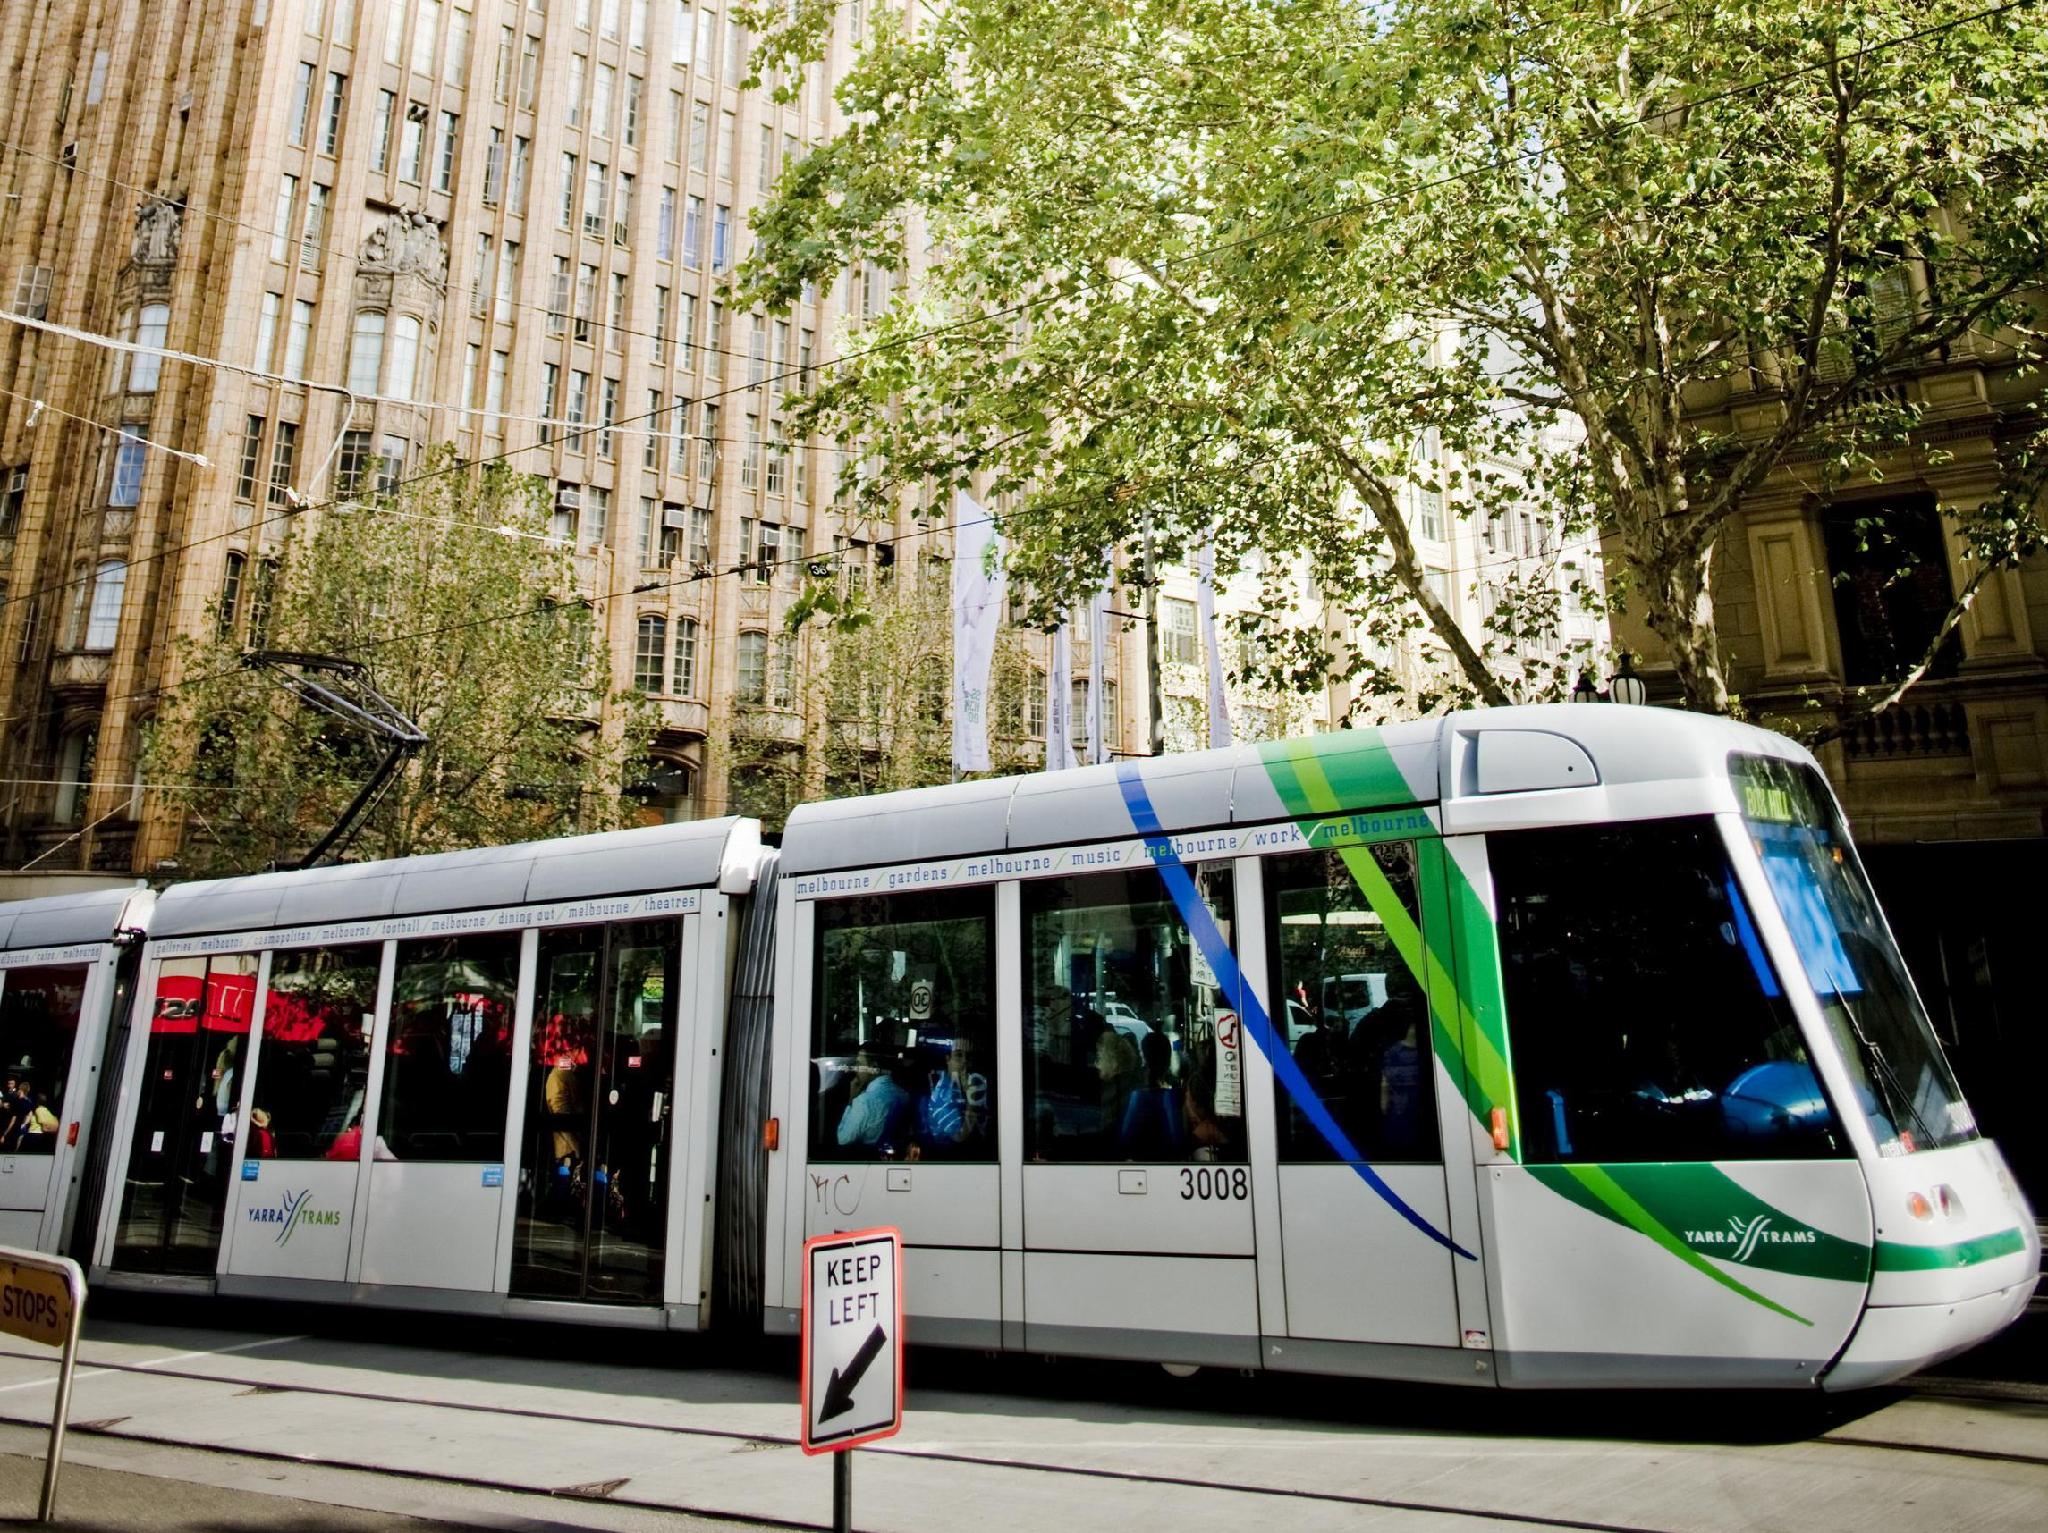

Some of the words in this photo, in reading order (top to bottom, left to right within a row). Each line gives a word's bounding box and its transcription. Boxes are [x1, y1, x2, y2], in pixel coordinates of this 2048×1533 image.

[797, 876, 870, 894] melbourne
[889, 867, 947, 889] gardens
[967, 856, 1051, 877] melbourne
[1072, 848, 1121, 865] music
[1144, 834, 1238, 859] melbourne
[1255, 825, 1300, 846] work
[1323, 814, 1429, 839] melbourne
[322, 926, 371, 940] melbourne
[431, 915, 486, 931] melbourne
[498, 910, 532, 925] dining
[537, 909, 555, 921] out
[568, 902, 629, 918] melbourne
[644, 896, 695, 911] theatres
[1180, 1168, 1248, 1200] 3008
[248, 1208, 284, 1223] YARRA
[301, 1210, 341, 1226] TRAMS
[1684, 1230, 1739, 1243] YARRA
[1760, 1230, 1816, 1243] TRAMS
[827, 1254, 881, 1287] KEEP
[3, 1285, 57, 1328] STOPS
[829, 1292, 880, 1326] LEFT
